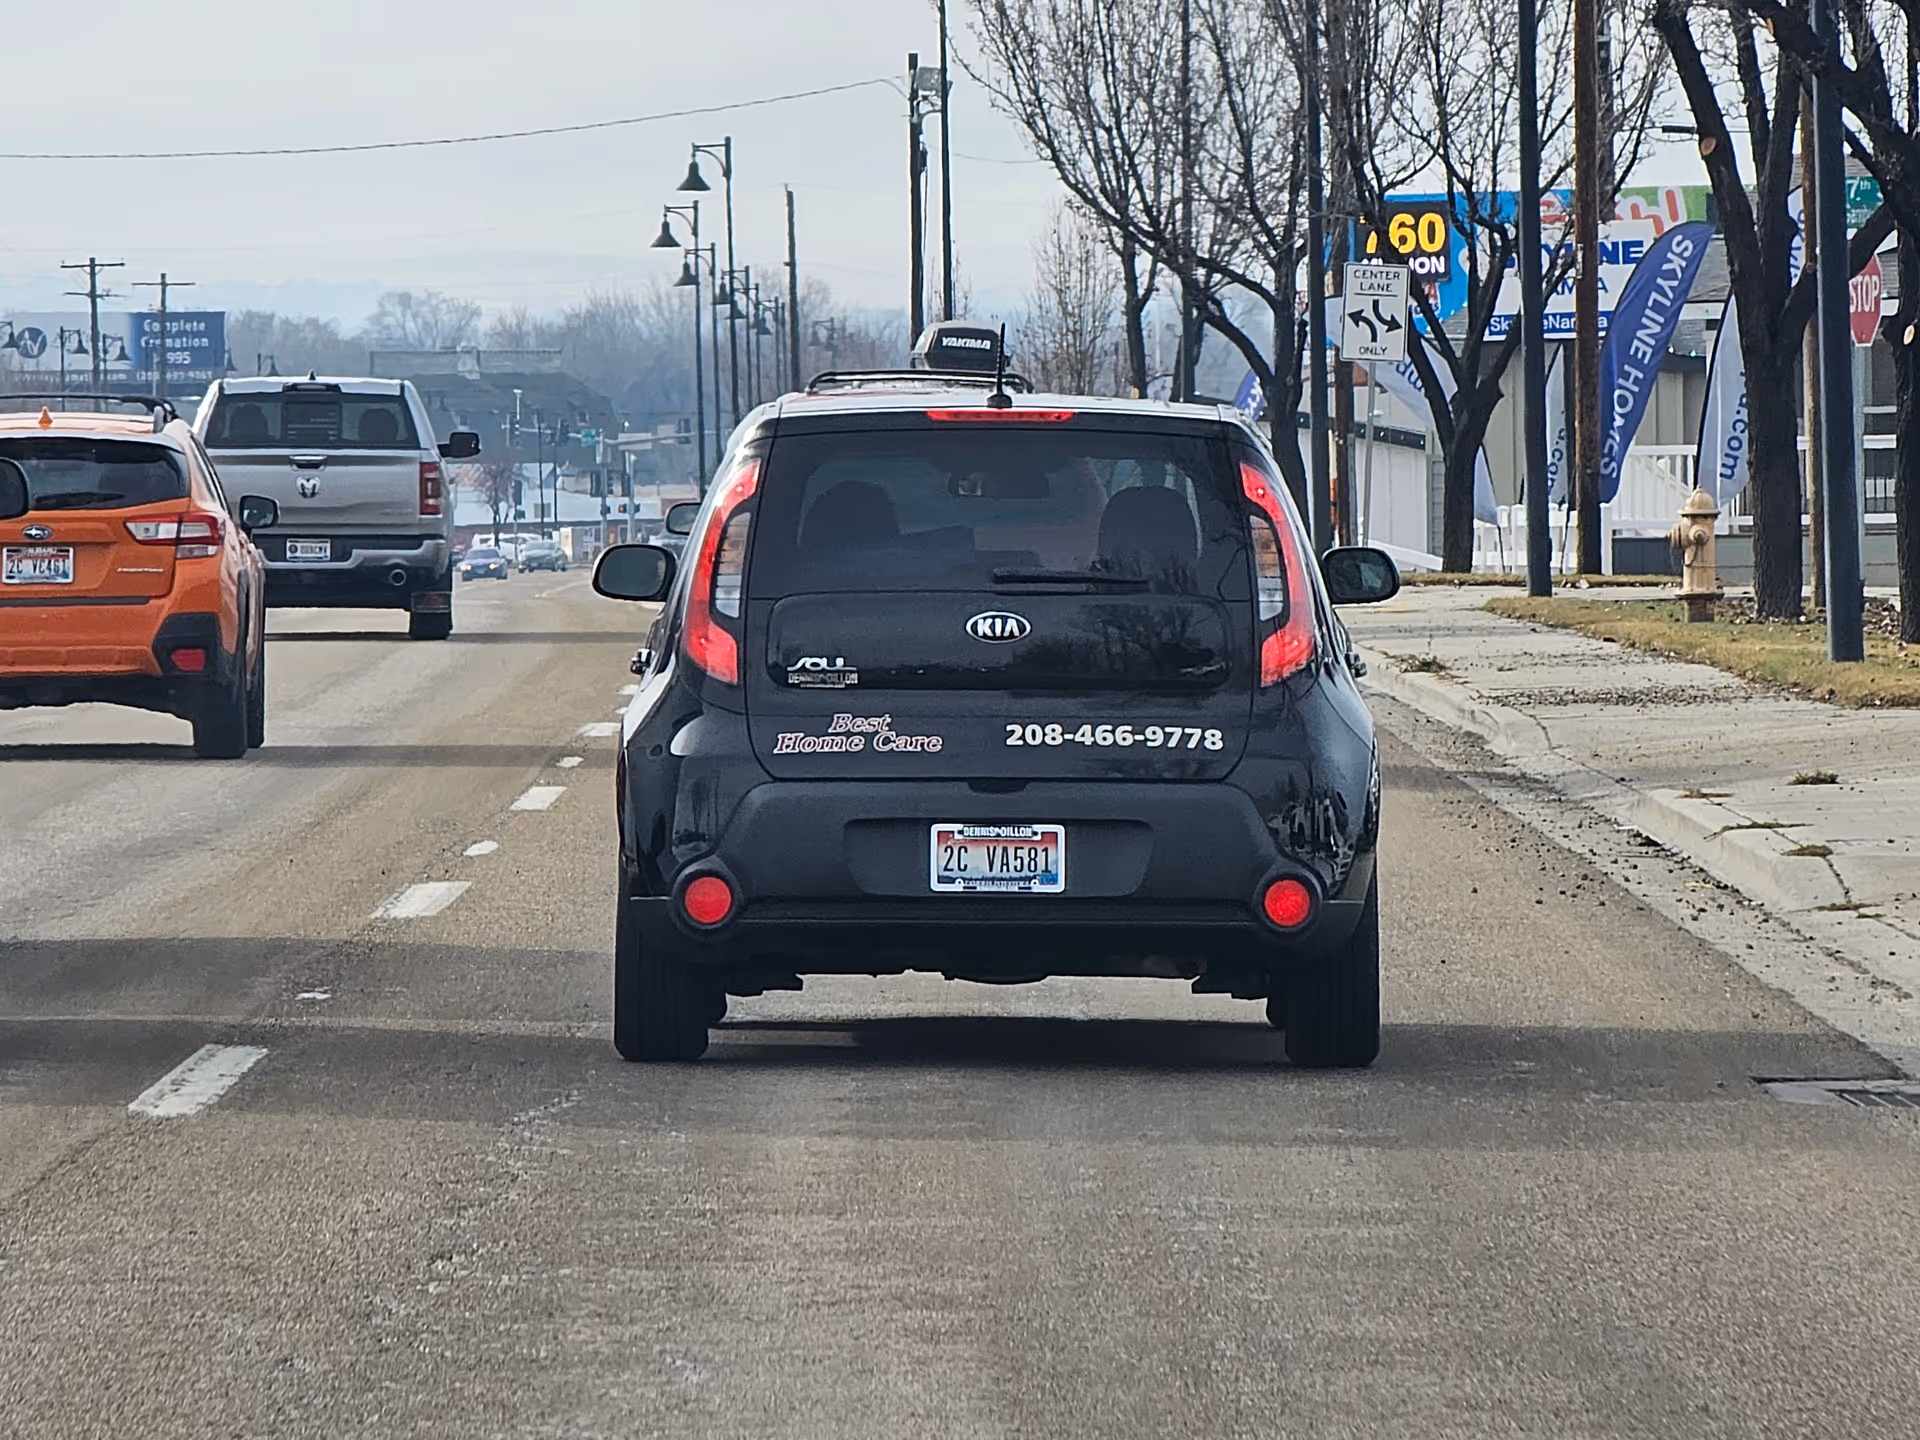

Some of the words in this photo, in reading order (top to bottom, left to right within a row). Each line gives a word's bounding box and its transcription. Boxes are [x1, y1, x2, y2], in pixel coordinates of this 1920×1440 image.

[1353, 269, 1401, 281] CENTER
[1360, 282, 1393, 293] LANE
[1849, 275, 1880, 313] STOP
[1630, 234, 1694, 364] SKYLINE
[942, 336, 991, 350] YAKIMA
[1359, 345, 1388, 356] ONLY
[1600, 364, 1644, 478] HOMES
[9, 559, 23, 574] 2C
[977, 617, 1020, 637] KIA
[787, 656, 857, 671] SOUL
[828, 713, 892, 734] Best
[773, 732, 865, 754] Home
[873, 731, 943, 752] Care
[1005, 723, 1224, 751] 208-466-9778
[1000, 825, 1033, 838] DILLON
[943, 845, 968, 872] 2C
[986, 845, 1052, 873] VA581
